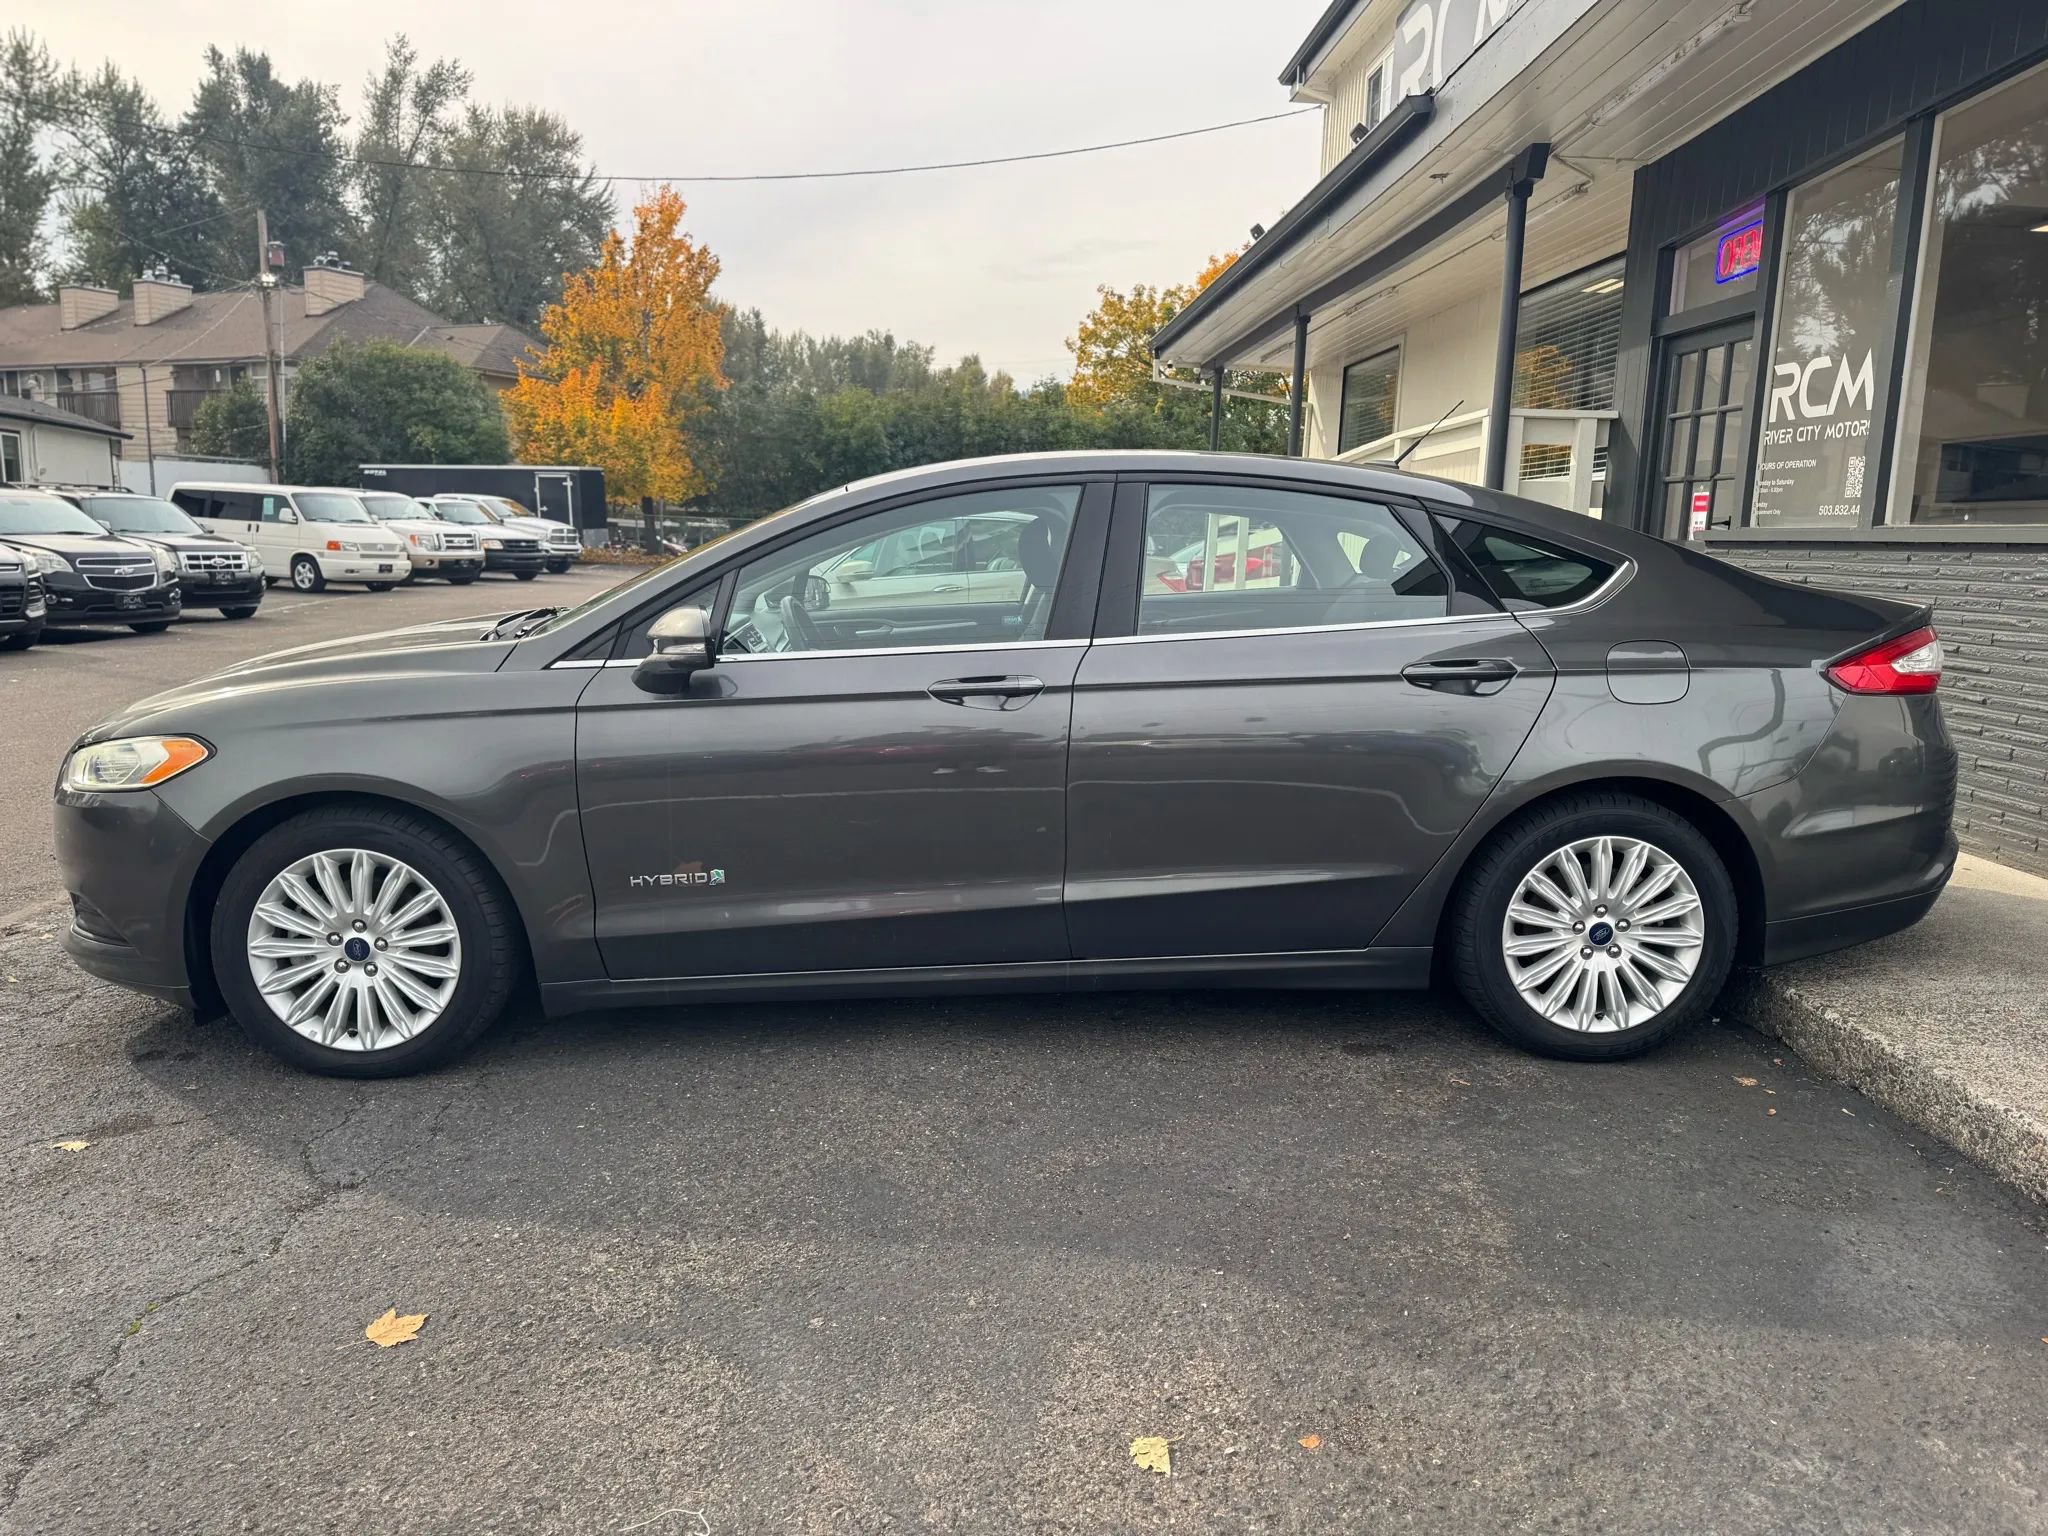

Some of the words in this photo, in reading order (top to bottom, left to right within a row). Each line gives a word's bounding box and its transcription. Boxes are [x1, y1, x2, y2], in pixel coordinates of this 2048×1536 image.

[1769, 348, 1874, 423] RCM
[1764, 428, 1793, 446] RIVER
[1796, 425, 1821, 442] CITY
[1776, 461, 1784, 469] OF
[1784, 459, 1817, 469] OPERATION
[629, 872, 708, 887] HYBRID
